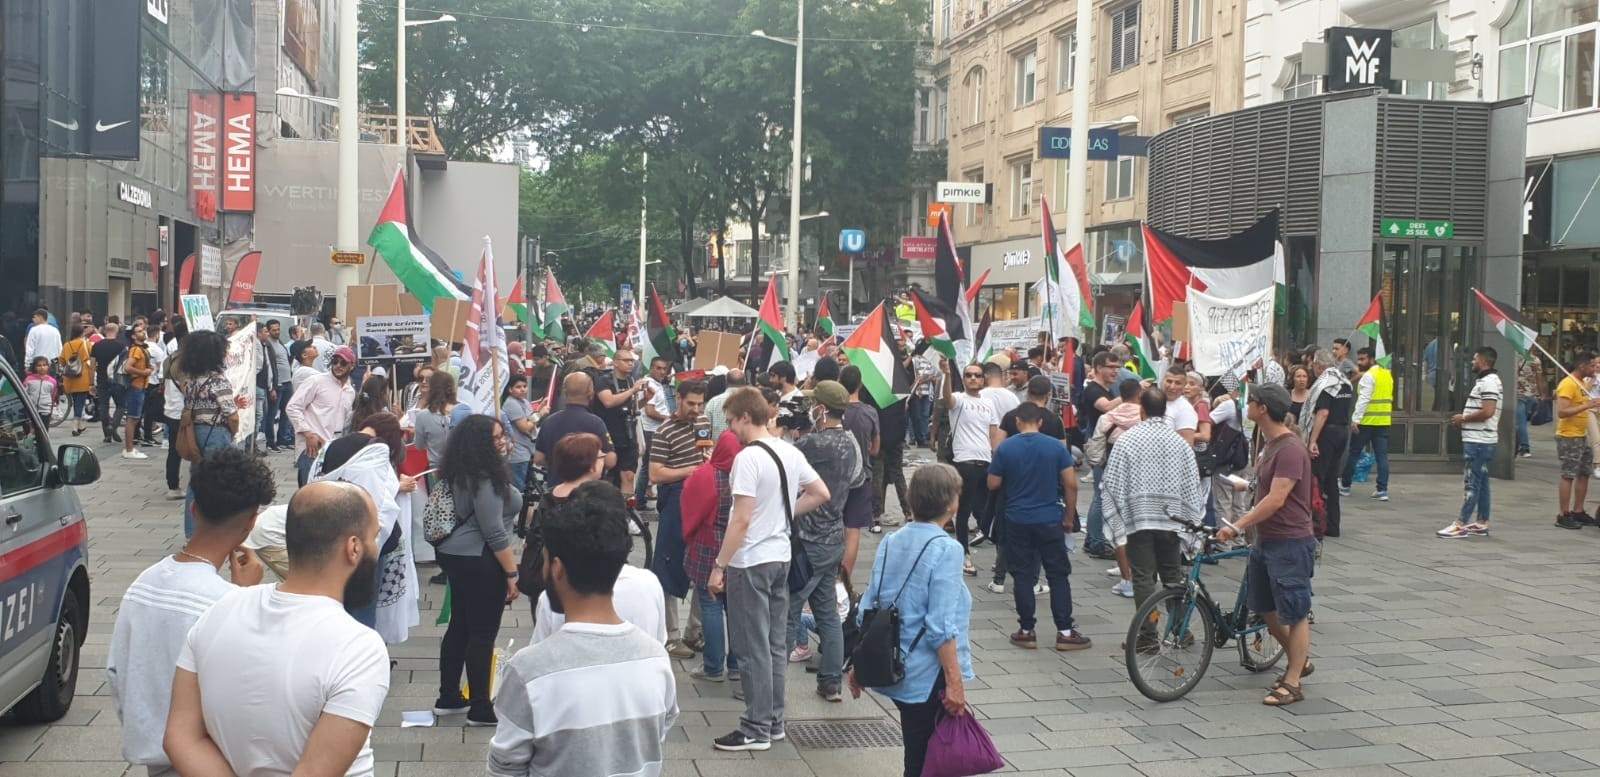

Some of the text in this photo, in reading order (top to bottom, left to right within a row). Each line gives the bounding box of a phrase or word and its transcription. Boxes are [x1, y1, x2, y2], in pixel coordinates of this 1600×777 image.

[1345, 36, 1381, 84] WMF
[227, 113, 251, 191] HEMA
[1051, 136, 1109, 151] DOLAS
[120, 181, 152, 209] CALZEDONIA
[943, 187, 981, 197] pimkie
[847, 233, 862, 251] U
[1002, 249, 1031, 272] pimkie
